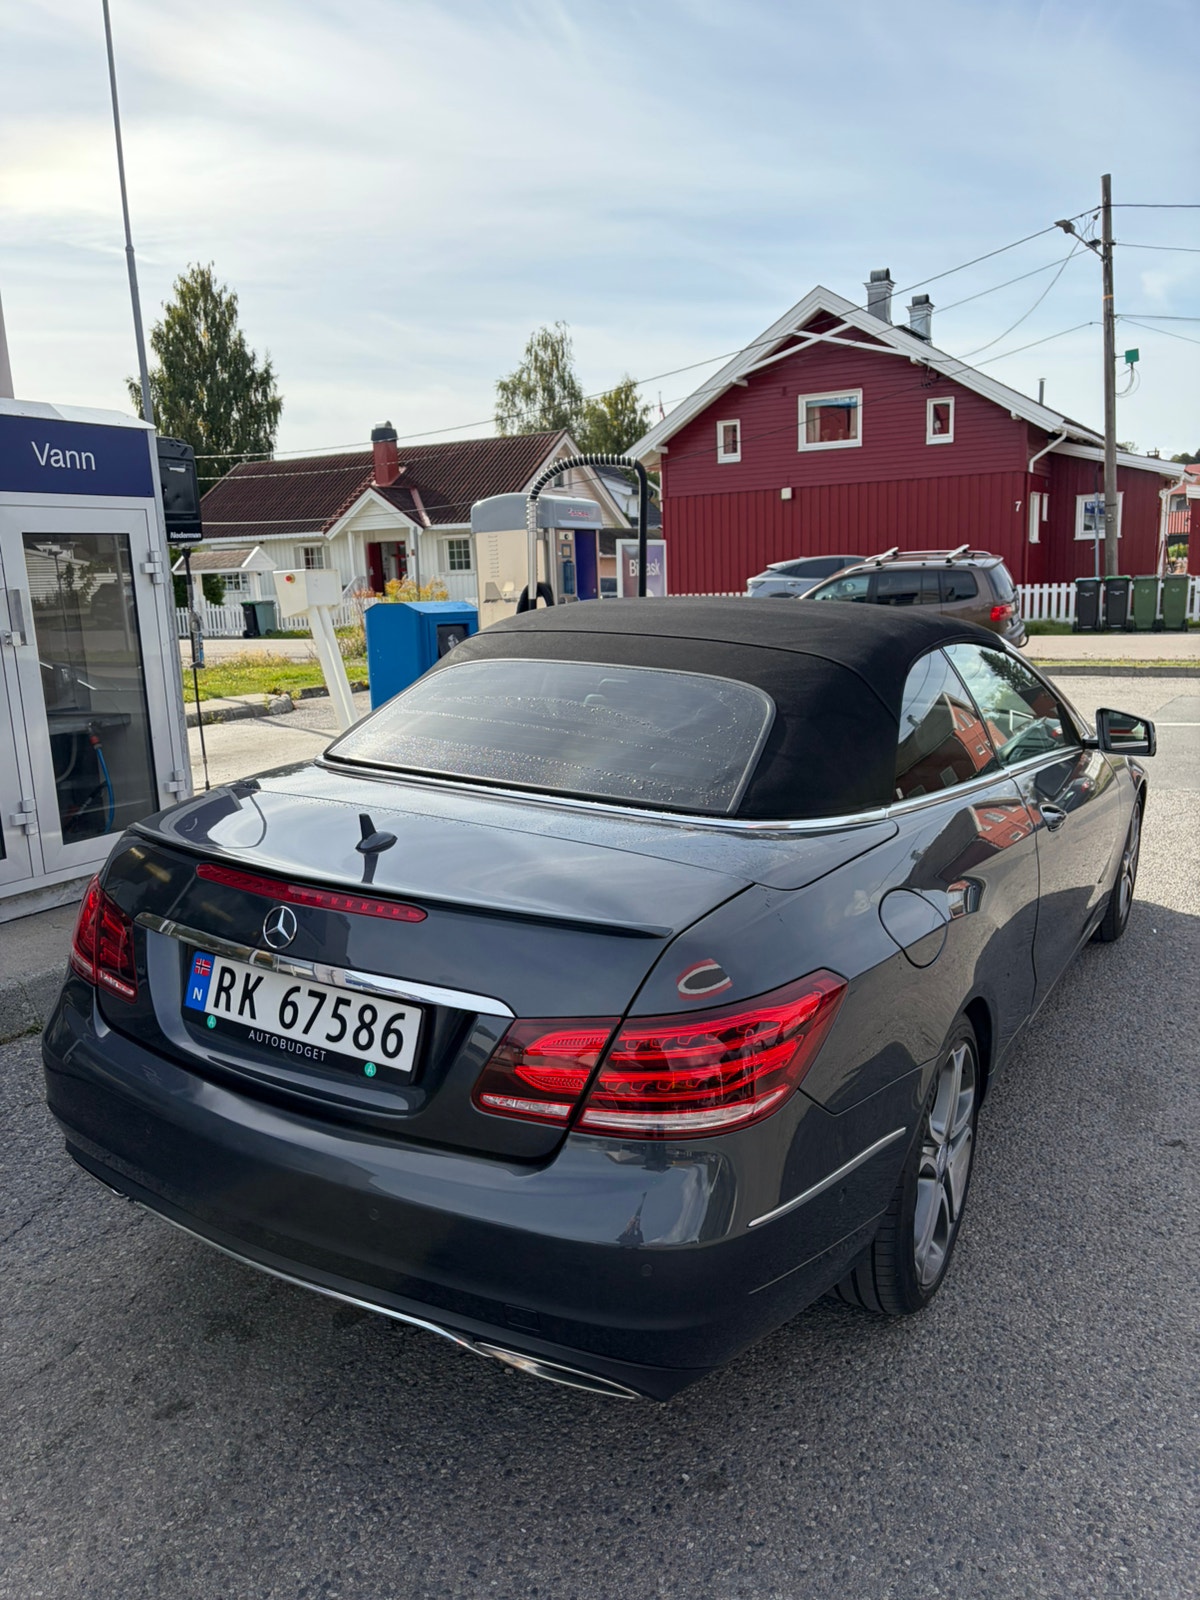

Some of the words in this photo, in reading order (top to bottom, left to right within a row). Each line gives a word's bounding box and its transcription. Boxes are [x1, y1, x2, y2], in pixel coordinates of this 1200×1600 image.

[31, 441, 96, 470] Vann
[1015, 501, 1022, 512] 7
[629, 559, 660, 577] Biask
[192, 987, 203, 1001] N
[213, 966, 264, 1020] RK
[278, 985, 405, 1059] 67586
[248, 1029, 327, 1061] AUTOBUDGET
